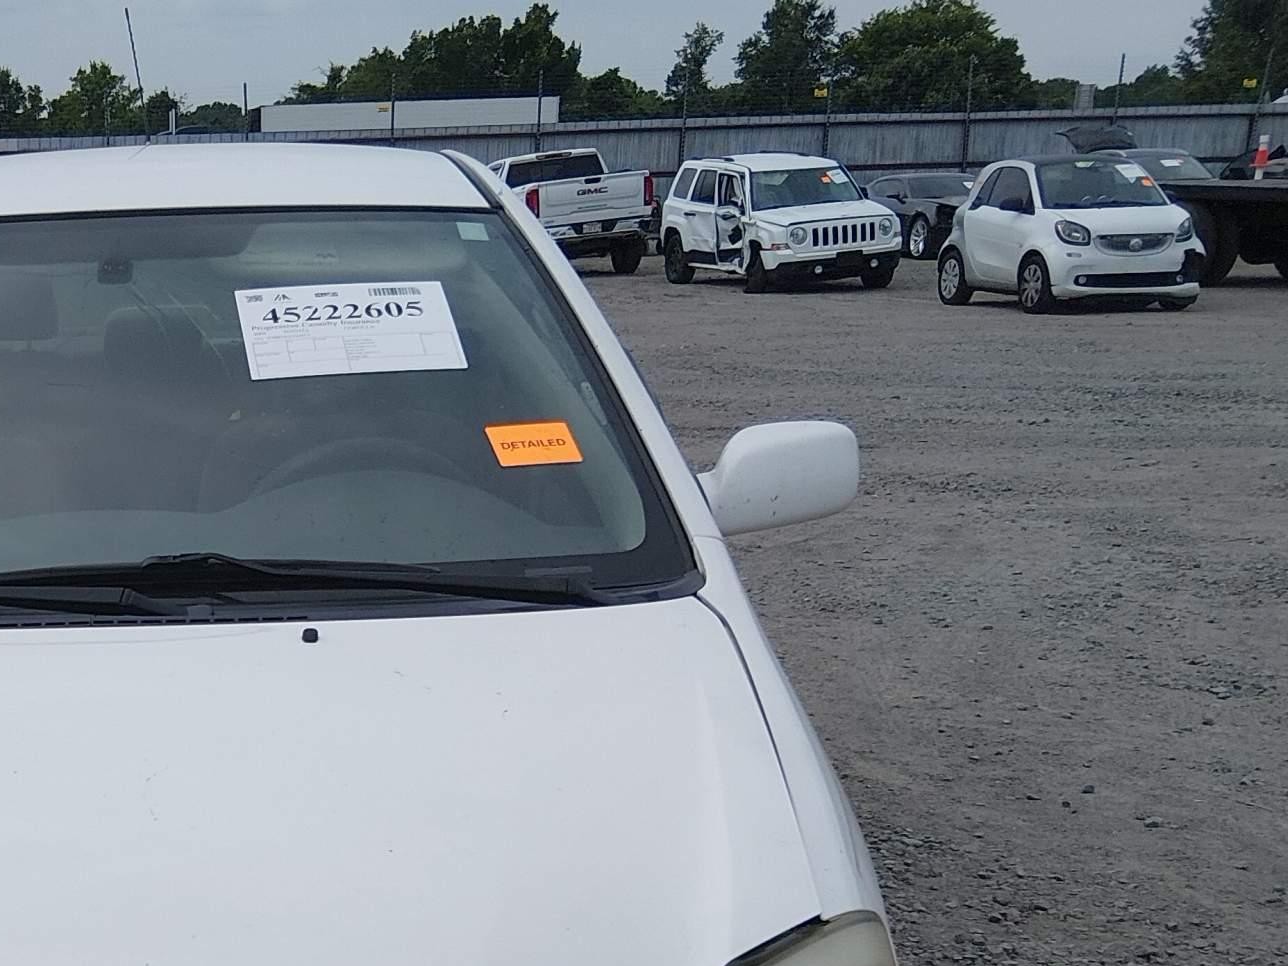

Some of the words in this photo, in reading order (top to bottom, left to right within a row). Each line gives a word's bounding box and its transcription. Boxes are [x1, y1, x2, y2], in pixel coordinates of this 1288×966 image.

[576, 186, 609, 196] GMC
[263, 300, 424, 324] 45222605
[500, 437, 567, 451] DETAILED
